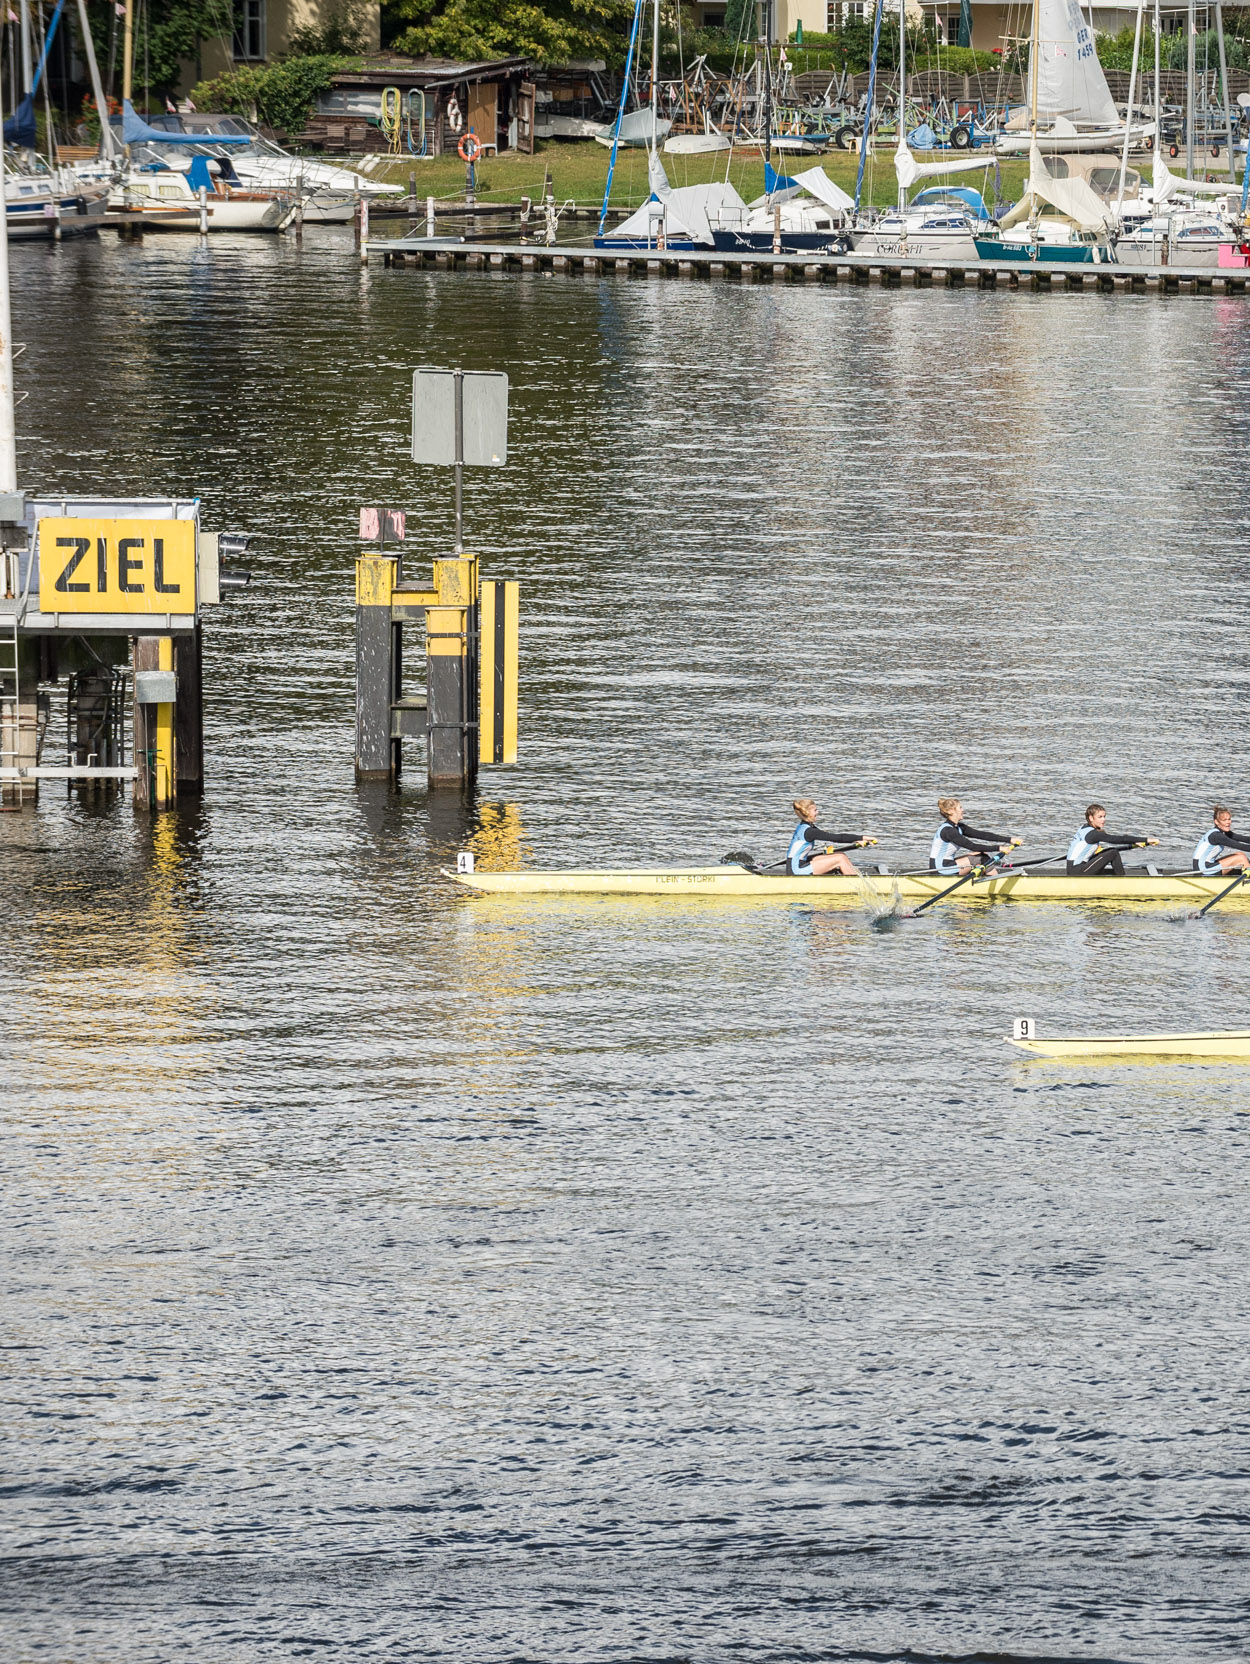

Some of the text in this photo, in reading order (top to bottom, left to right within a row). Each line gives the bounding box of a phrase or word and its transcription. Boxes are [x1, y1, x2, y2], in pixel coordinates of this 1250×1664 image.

[1077, 28, 1089, 44] GER
[54, 537, 181, 594] ZIEL
[460, 855, 467, 870] 4
[1020, 1020, 1029, 1036] 9
